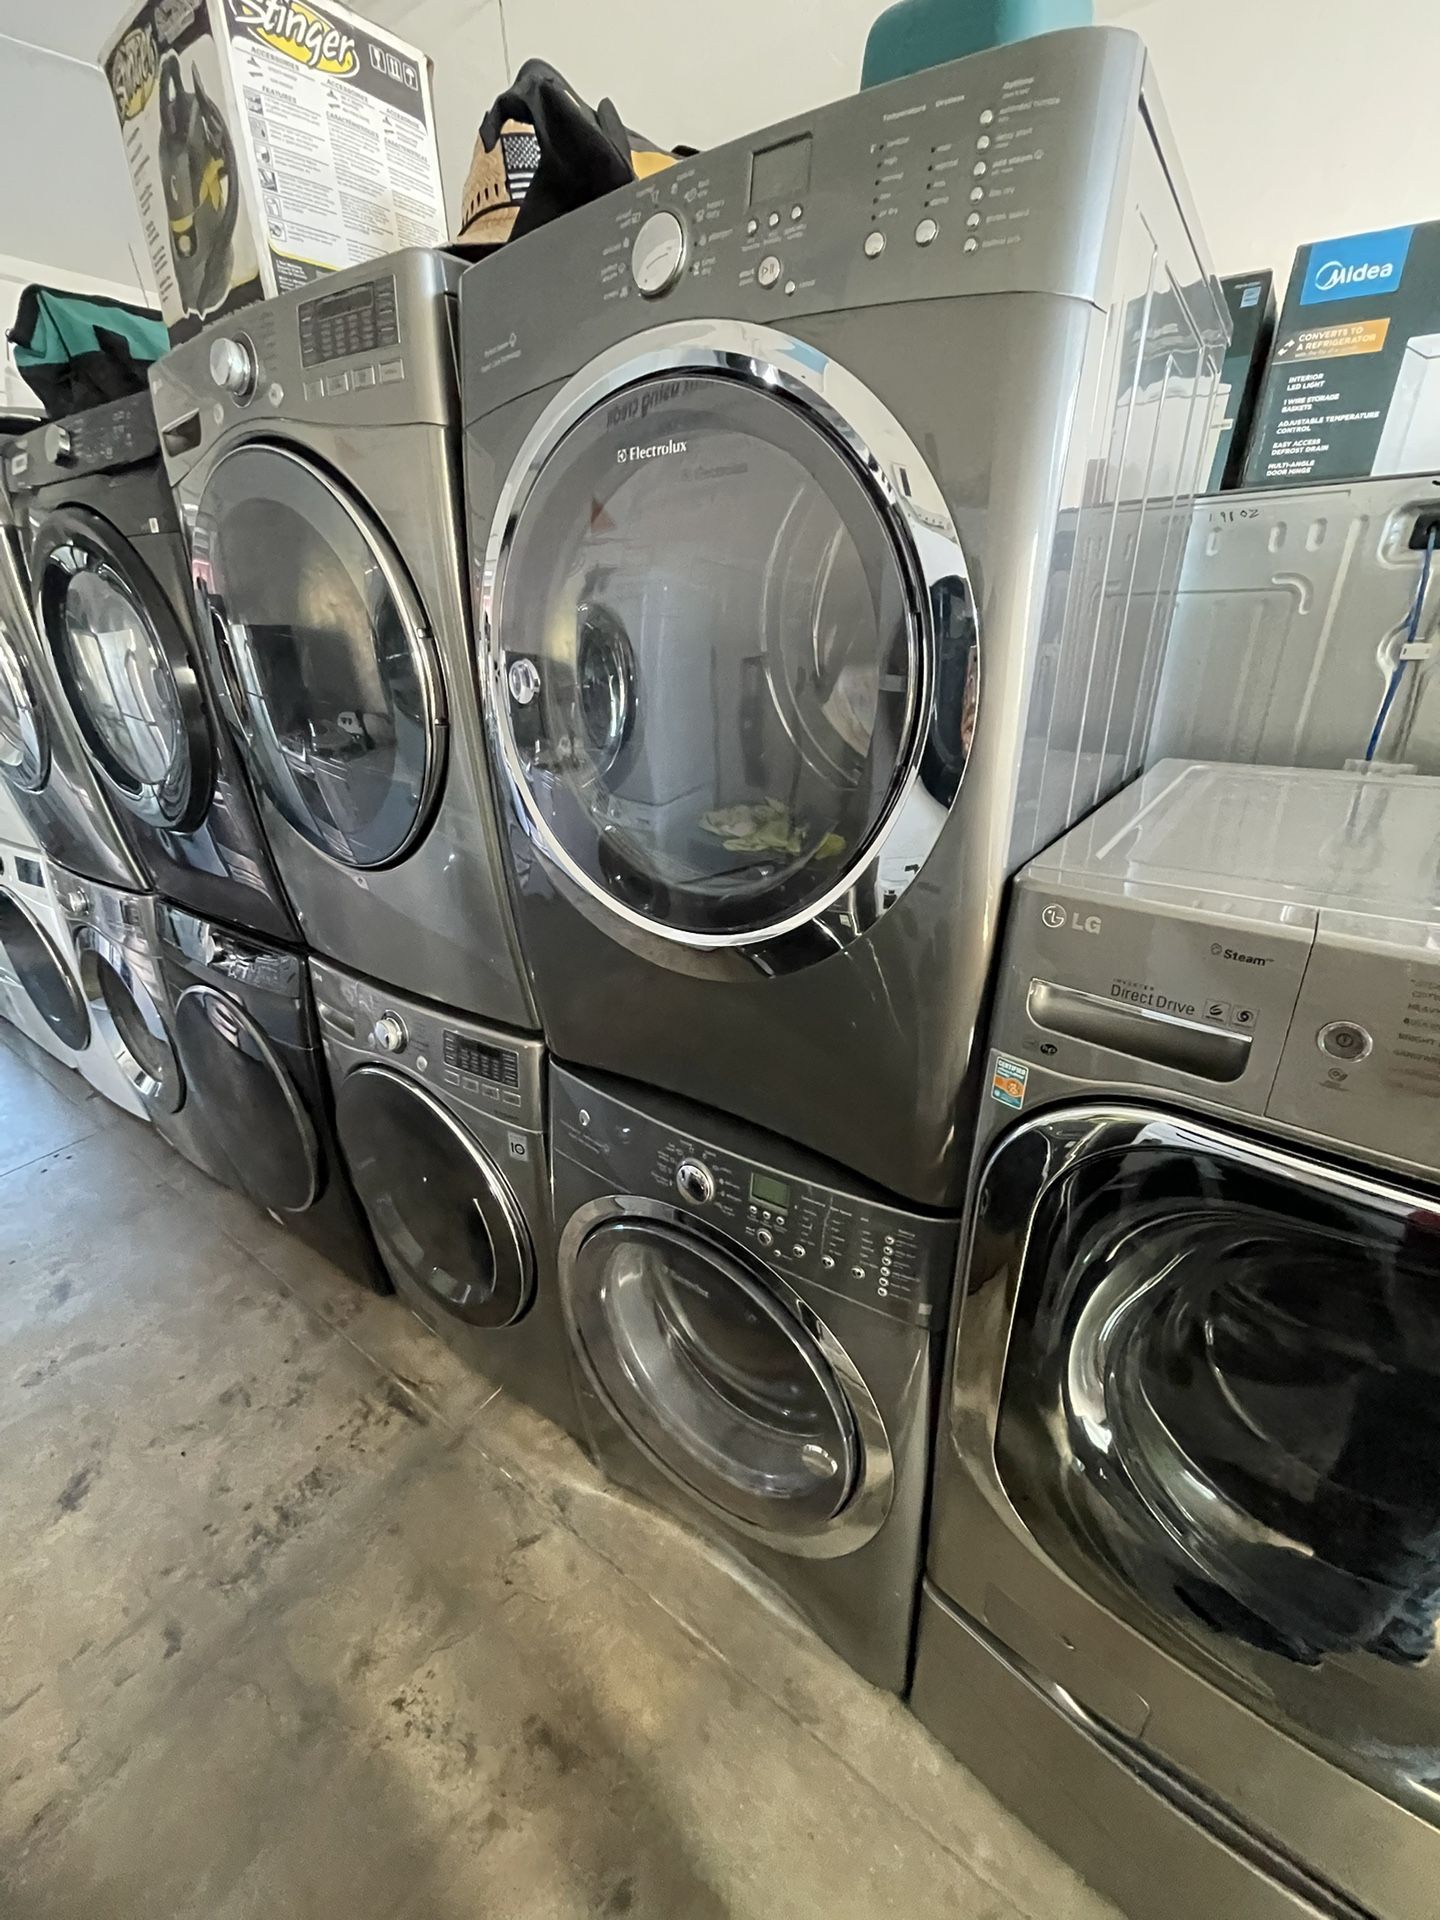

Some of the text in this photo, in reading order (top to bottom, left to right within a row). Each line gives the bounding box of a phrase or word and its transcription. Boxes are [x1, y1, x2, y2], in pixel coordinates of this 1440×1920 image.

[1315, 261, 1394, 291] Midea
[1298, 326, 1364, 343] CONVERTS TO
[1296, 343, 1303, 352] A
[1305, 333, 1377, 351] REFRIGERATOR
[1288, 373, 1324, 384] INTERIOR
[1286, 380, 1326, 392] LED LIGHT
[1306, 393, 1340, 403] STORAGE
[1281, 403, 1313, 413] BASKETS
[1277, 411, 1380, 428] ADJUSTABLE TEMPERATURE
[1276, 425, 1311, 435] CONTROL
[1272, 438, 1321, 449] EASY ACCESS
[629, 439, 688, 461] Electrolux
[1271, 444, 1330, 456] DEFROST DRAIN
[1267, 459, 1315, 470] MULTI-ANGLE
[1266, 468, 1287, 477] DOOR
[1072, 912, 1102, 935] LG
[1223, 948, 1266, 967] Steam
[1110, 983, 1196, 1017] Direct Drive
